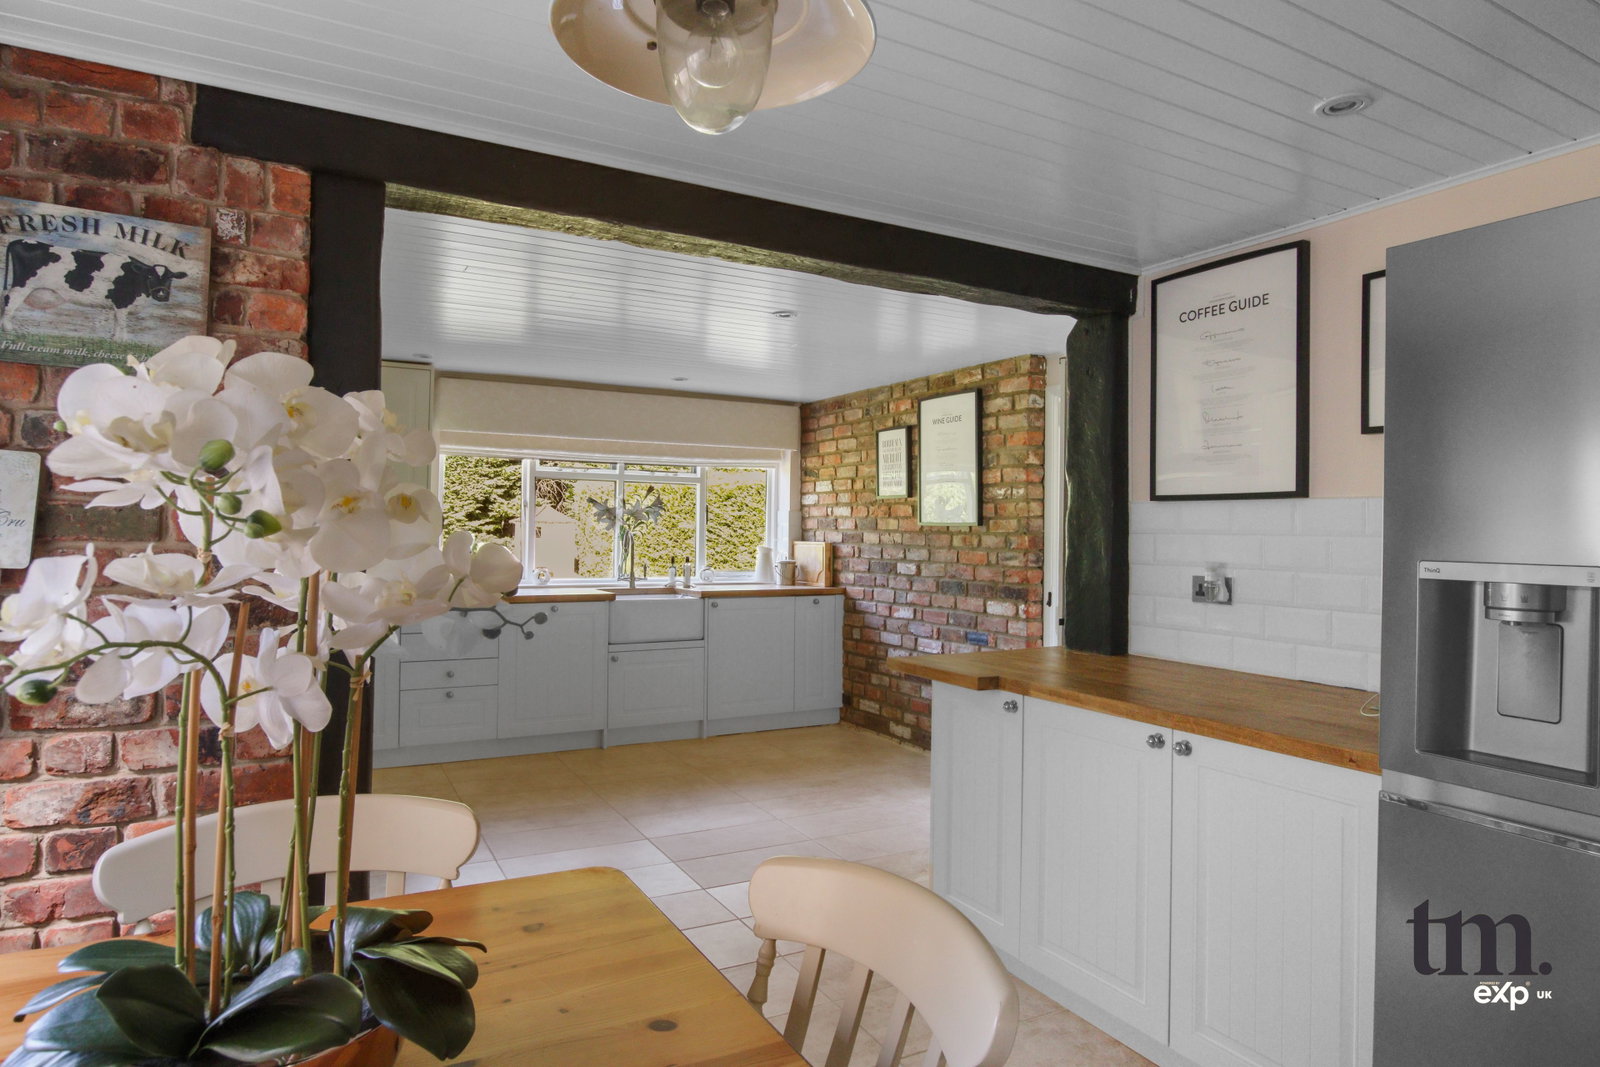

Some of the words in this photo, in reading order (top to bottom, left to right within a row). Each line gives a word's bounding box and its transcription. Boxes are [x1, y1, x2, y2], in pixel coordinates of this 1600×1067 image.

[0, 214, 101, 236] FRESH
[114, 222, 190, 259] MILK
[1179, 303, 1226, 323] COFFEE
[1228, 293, 1270, 312] GUIDE
[1, 340, 26, 350] Full
[27, 345, 60, 353] cream
[932, 417, 945, 425] WINE
[945, 415, 962, 424] GUIDE
